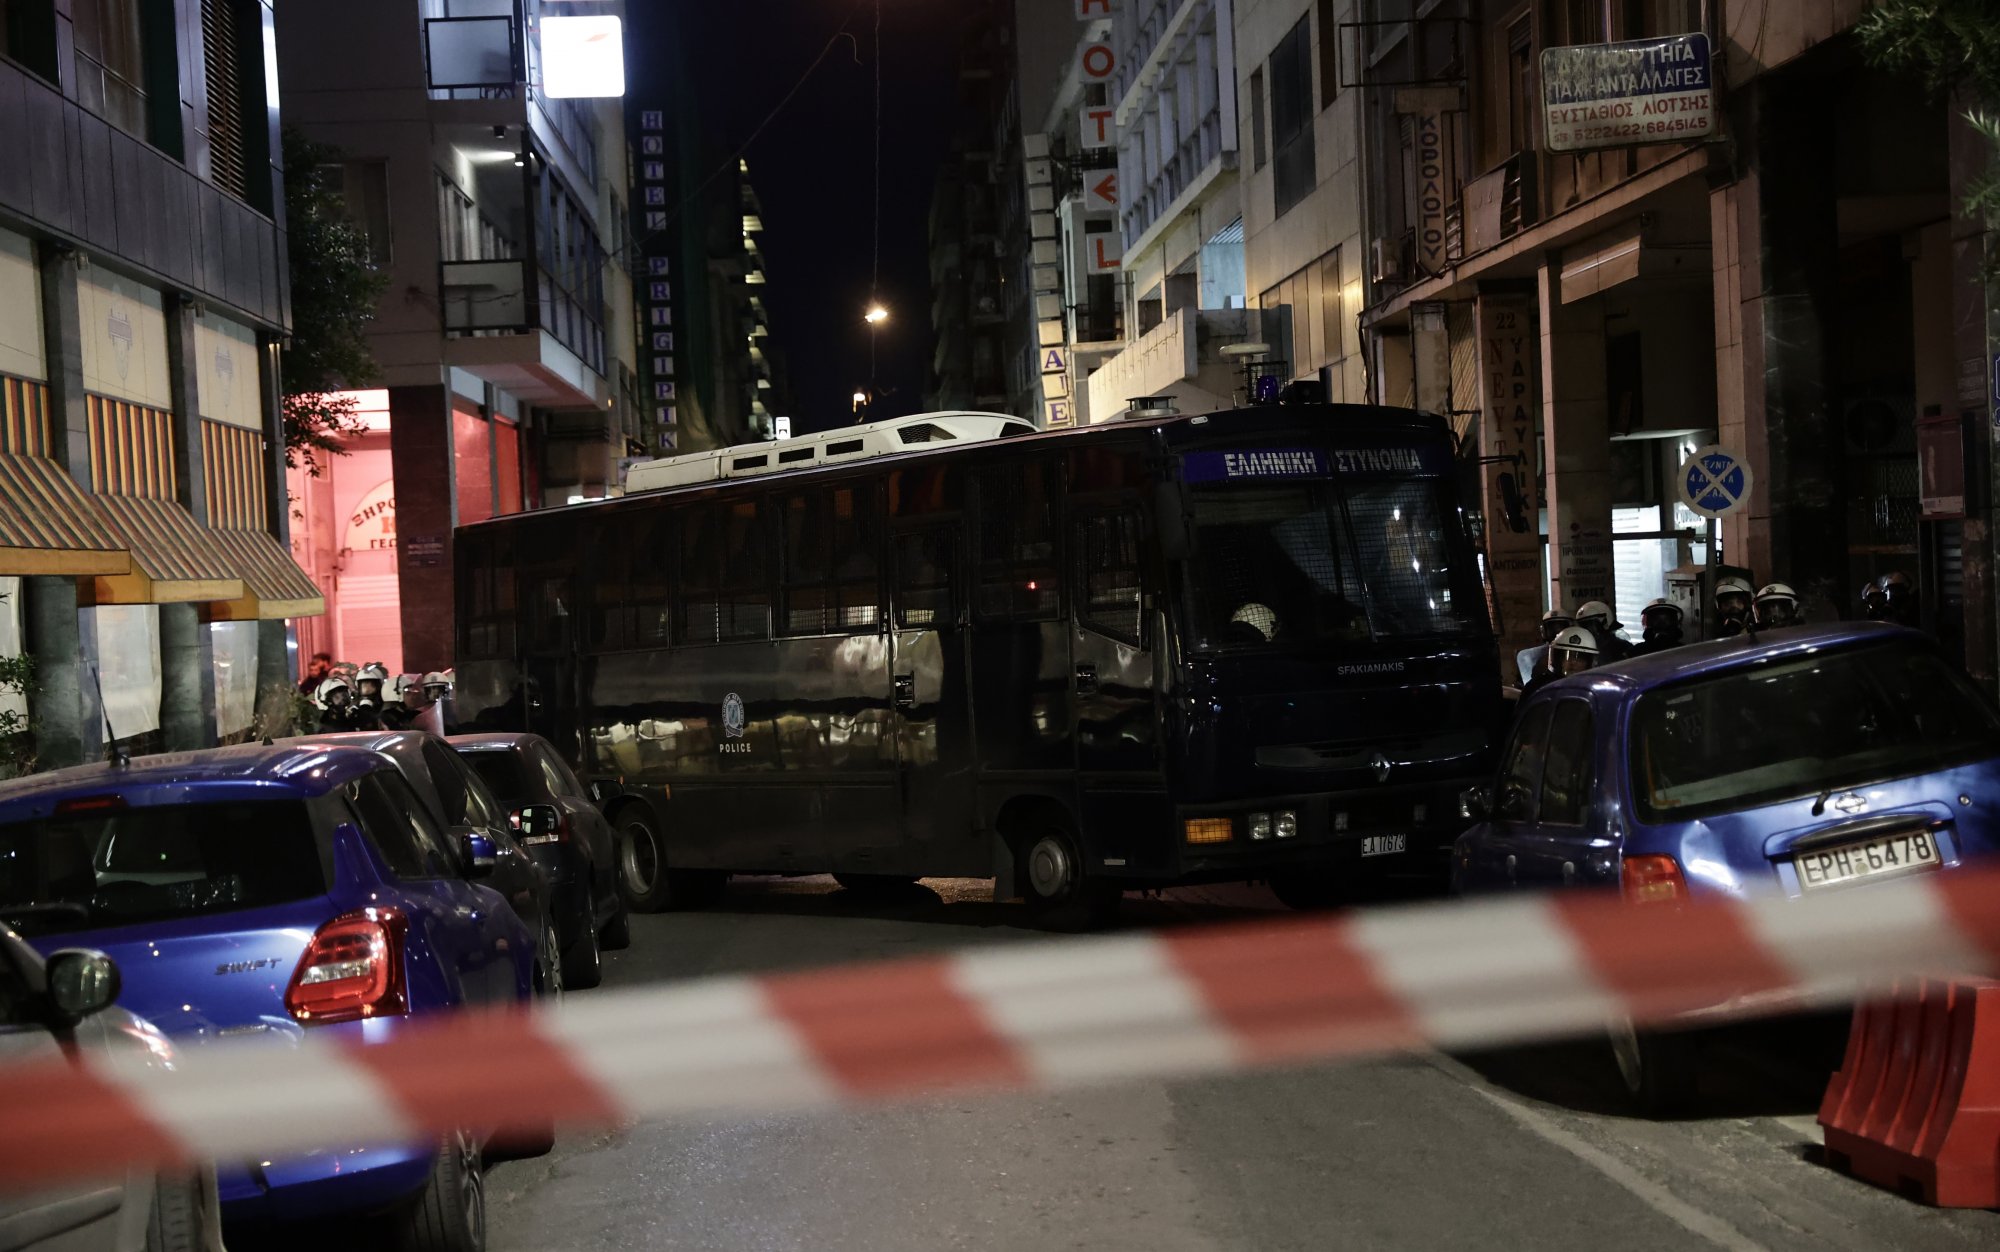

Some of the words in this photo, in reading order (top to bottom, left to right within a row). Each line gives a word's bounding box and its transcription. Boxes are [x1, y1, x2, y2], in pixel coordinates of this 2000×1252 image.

[1551, 102, 1633, 125] ΕΥΣΤΑΘΙΟΣ
[1642, 95, 1709, 116] ΛΙΟΤΣΗΣ
[644, 113, 665, 229] HOTEL
[1495, 311, 1516, 329] 22
[1224, 451, 1318, 477] ΕΛΛΗΝΙΚΗ
[1327, 449, 1423, 473] ΣΤΥΝΟΜΙΑ
[1337, 661, 1405, 675] SFAKIANAKIS
[719, 742, 752, 753] POLICE
[214, 958, 282, 976] SWIFT
